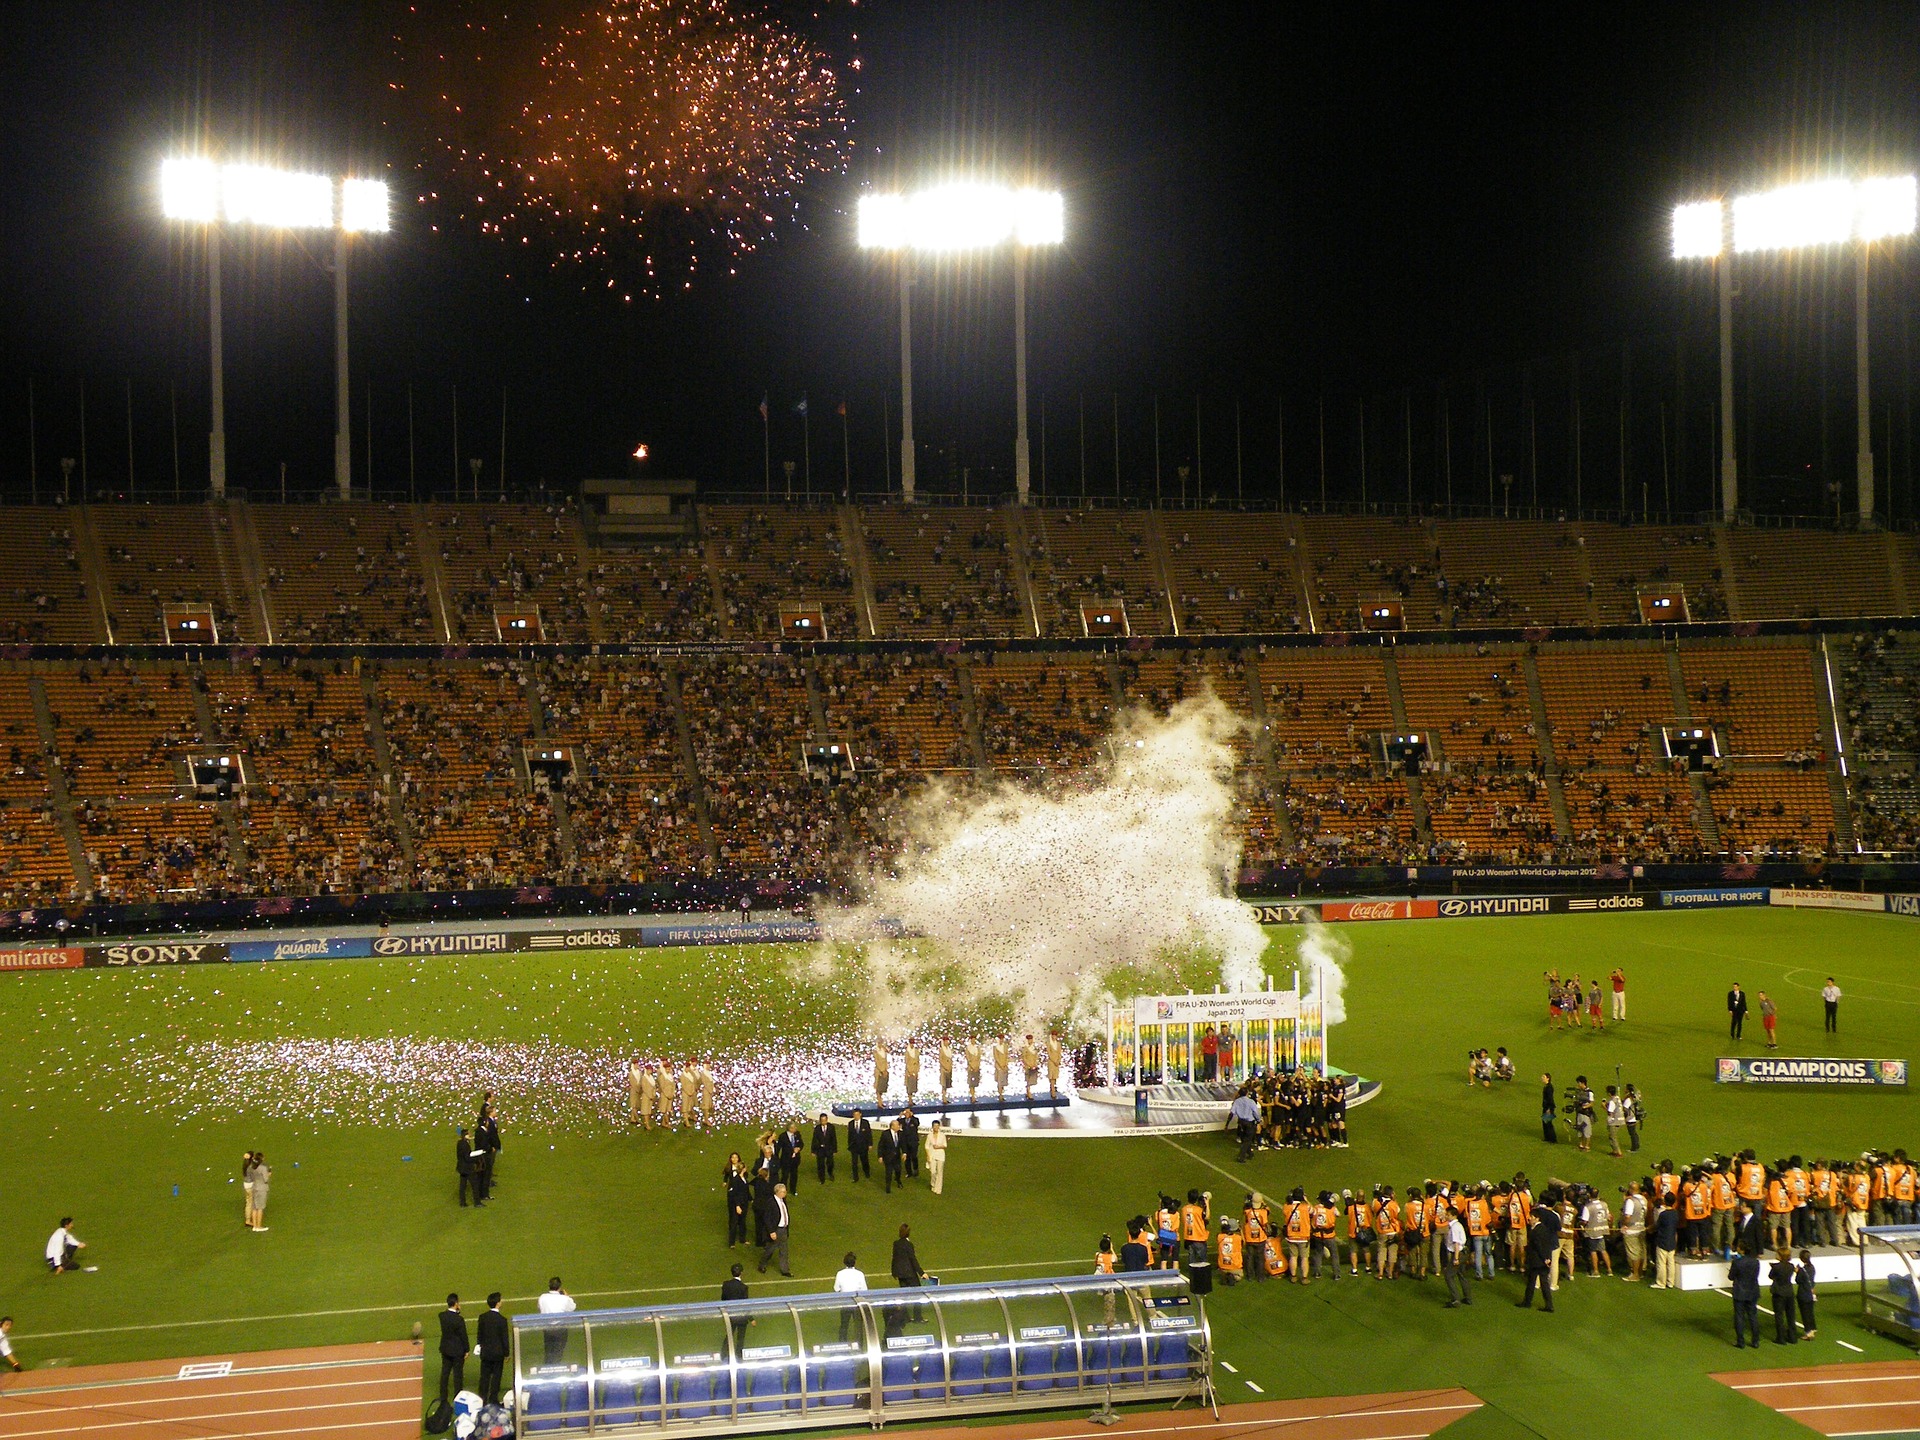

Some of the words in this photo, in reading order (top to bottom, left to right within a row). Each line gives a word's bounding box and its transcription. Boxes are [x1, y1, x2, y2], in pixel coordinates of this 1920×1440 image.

[1542, 869, 1557, 877] Cup
[1557, 868, 1579, 876] Japan
[1580, 868, 1597, 876] 2012
[1598, 895, 1644, 908] adidas
[1674, 893, 1719, 903] FOOTBALL
[1721, 893, 1738, 901] FOR
[1740, 892, 1763, 900] HOPE
[1781, 890, 1808, 898] JAPAN
[1811, 891, 1838, 899] SPORT
[1840, 893, 1874, 902] COUNCIL
[1350, 902, 1395, 919] Coca-Cola
[1470, 897, 1549, 914] HYUNDAI
[1890, 895, 1920, 916] VISA
[1251, 906, 1304, 922] ONY
[566, 932, 621, 947] adidas
[669, 930, 691, 940] FIFA
[274, 941, 328, 959] AQUARIUS
[411, 934, 506, 952] HYUNDAI
[0, 951, 67, 967] mirates
[107, 944, 206, 965] SONY
[1176, 1001, 1190, 1009] FIFA
[1191, 1000, 1208, 1008] U-20
[1209, 999, 1239, 1007] Women's
[1262, 998, 1276, 1006] Cup
[1208, 1009, 1228, 1018] Japan
[1749, 1061, 1866, 1077] CHAMPIONS
[1153, 1318, 1189, 1327] FIFA.com
[1023, 1328, 1060, 1337] FIFA.com
[603, 1360, 643, 1369] FIFA.com
